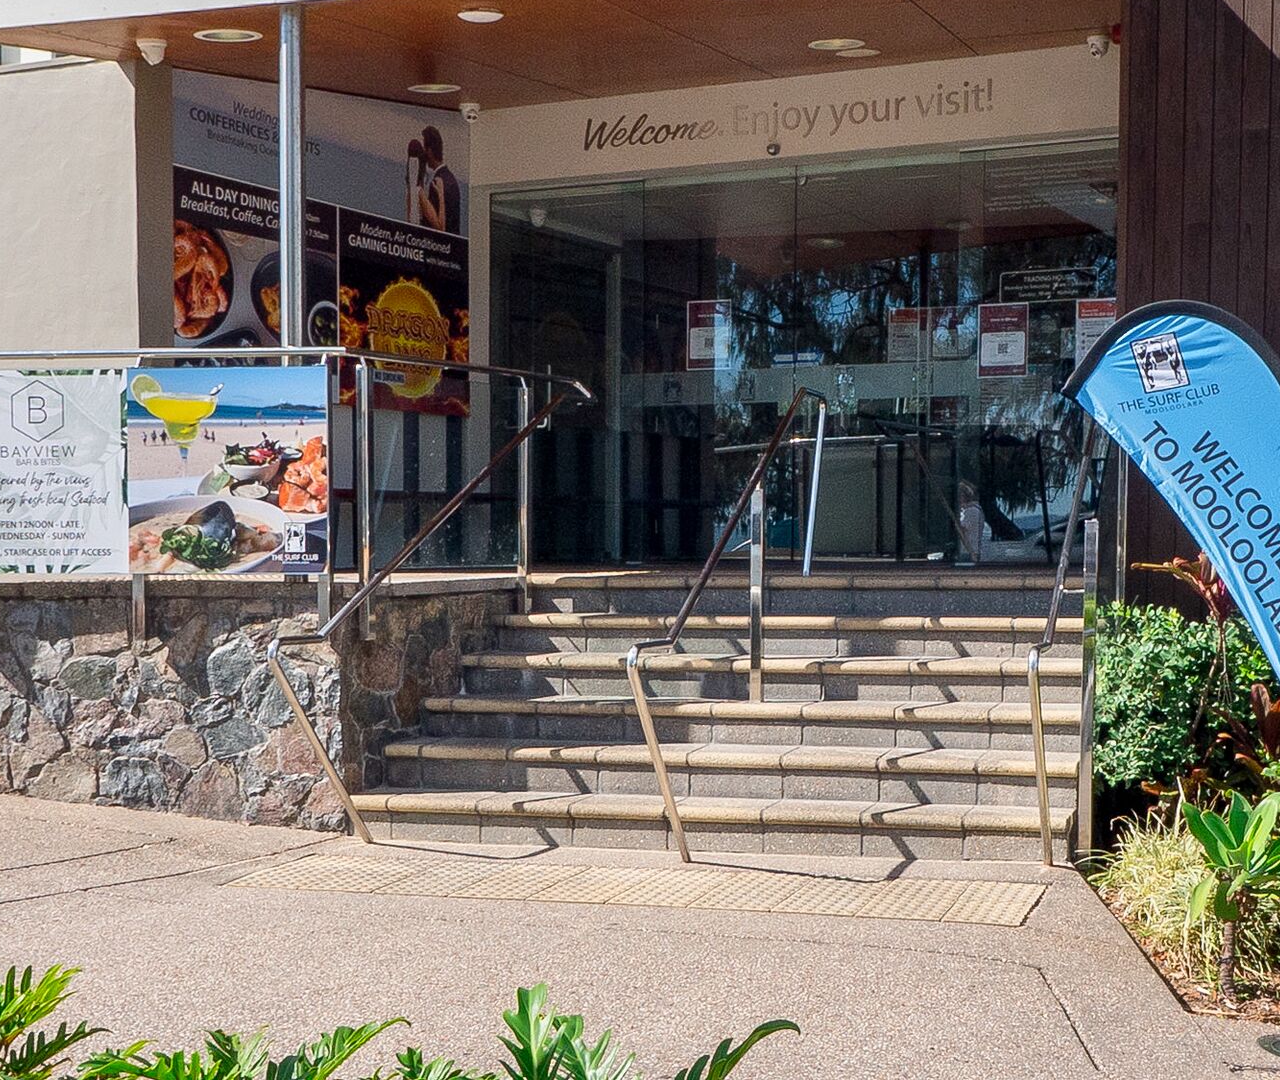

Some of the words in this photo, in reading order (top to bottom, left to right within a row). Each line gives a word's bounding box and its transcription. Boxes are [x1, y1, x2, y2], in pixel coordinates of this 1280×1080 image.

[233, 101, 280, 128] Wedding
[733, 101, 822, 142] Enjoy
[829, 95, 907, 137] your
[915, 78, 994, 119] visit!
[190, 107, 270, 142] CONFERENCES
[181, 195, 230, 220] Breakfast,
[232, 207, 264, 227] Coffee,
[192, 181, 213, 198] ALL
[215, 186, 239, 206] DAY
[241, 193, 280, 214] DINING
[348, 234, 387, 254] GAMING
[388, 243, 425, 262] LOUNGE
[360, 222, 393, 242] Modern,
[394, 230, 406, 244] Air
[406, 233, 452, 254] Conditioned
[366, 304, 451, 343] DRAGON
[28, 396, 47, 424] B
[1118, 398, 1146, 413] THE
[1147, 391, 1181, 408] SURF
[1185, 383, 1220, 400] CLUB
[1144, 399, 1204, 415] MOOLOOLABA
[0, 445, 77, 458] BAYVIEW
[1142, 420, 1179, 462] TO
[16, 458, 32, 466] BAR
[40, 458, 61, 466] BITES
[31, 472, 44, 491] by
[70, 490, 110, 507] Seafood
[19, 521, 54, 529] 12NOON
[52, 532, 86, 540] SUNDAY
[4, 548, 47, 556] STAIRCASE
[48, 548, 61, 556] OR
[63, 548, 79, 556] LIFT
[81, 548, 112, 556] ACCESS
